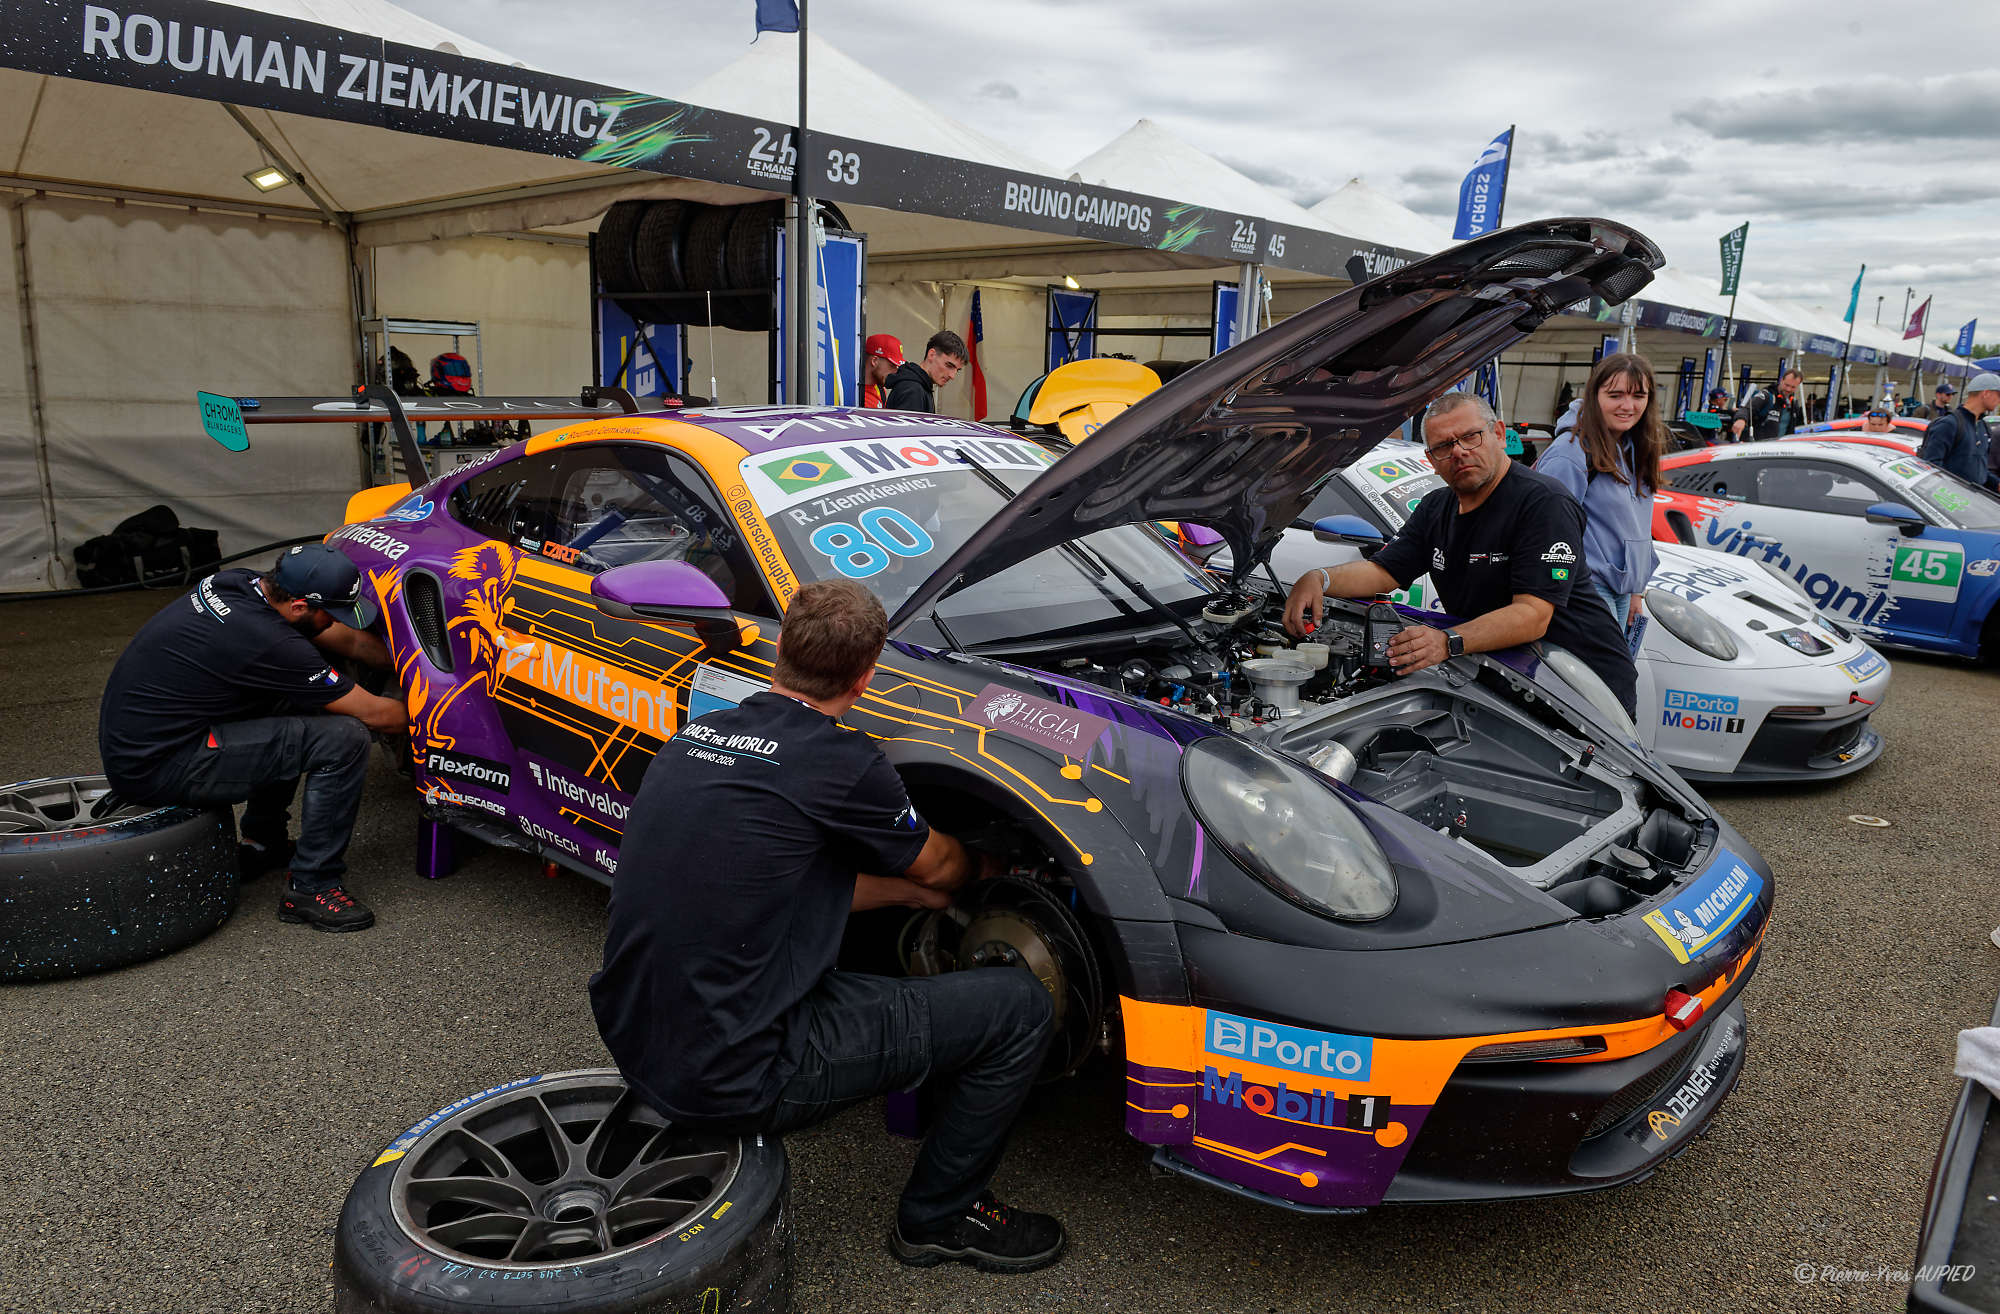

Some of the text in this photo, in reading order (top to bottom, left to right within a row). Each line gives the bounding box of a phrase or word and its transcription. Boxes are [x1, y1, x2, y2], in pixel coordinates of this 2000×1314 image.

[82, 5, 620, 142] ROUMAN ZIEMKIEWICZ
[749, 127, 798, 166] 24h
[747, 159, 795, 176] LE MANS
[826, 149, 861, 185] 33
[1004, 181, 1152, 233] BRUNO CAMPOS
[1268, 233, 1286, 258] 45
[205, 402, 241, 424] CHROMA
[840, 440, 1001, 475] Mobil
[817, 475, 937, 514] Ziemkiewicz
[808, 505, 937, 579] 80
[1541, 553, 1577, 563] DENER
[1899, 550, 1949, 581] 45
[542, 643, 673, 737] Mutant
[1685, 695, 1735, 714] Porto
[682, 723, 779, 755] RACE THE WORLD
[1013, 702, 1081, 740] HÍGIA
[1662, 710, 1722, 733] Mobil
[428, 754, 511, 788] Flexform
[686, 747, 737, 767] LE MANS 2026
[1693, 864, 1750, 928] MICHELIN
[1251, 1025, 1363, 1075] Porto
[410, 1077, 532, 1136] MICHELIN
[1202, 1064, 1335, 1127] Mobil
[1665, 1064, 1717, 1121] DENER
